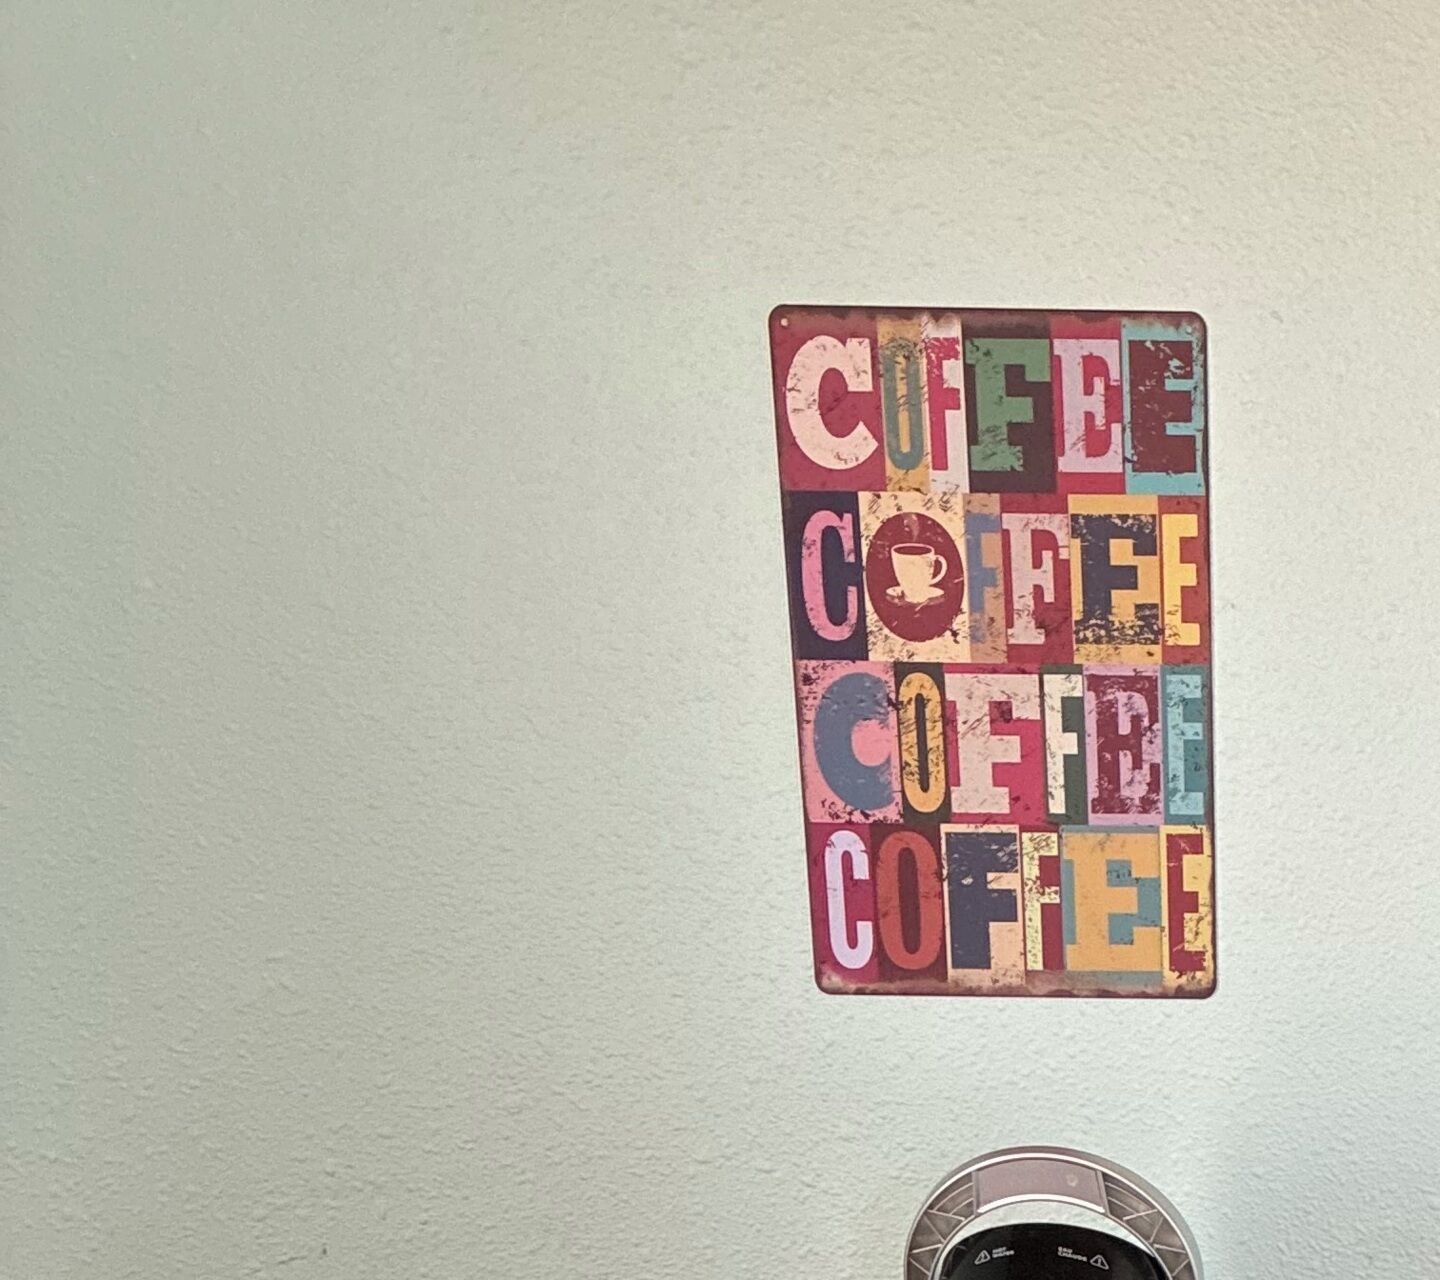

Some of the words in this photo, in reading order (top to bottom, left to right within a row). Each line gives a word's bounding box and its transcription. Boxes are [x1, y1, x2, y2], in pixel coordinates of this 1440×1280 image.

[785, 333, 1203, 474] COFFEE
[812, 671, 1205, 817] COFFEE
[823, 829, 1206, 973] COFFEE
